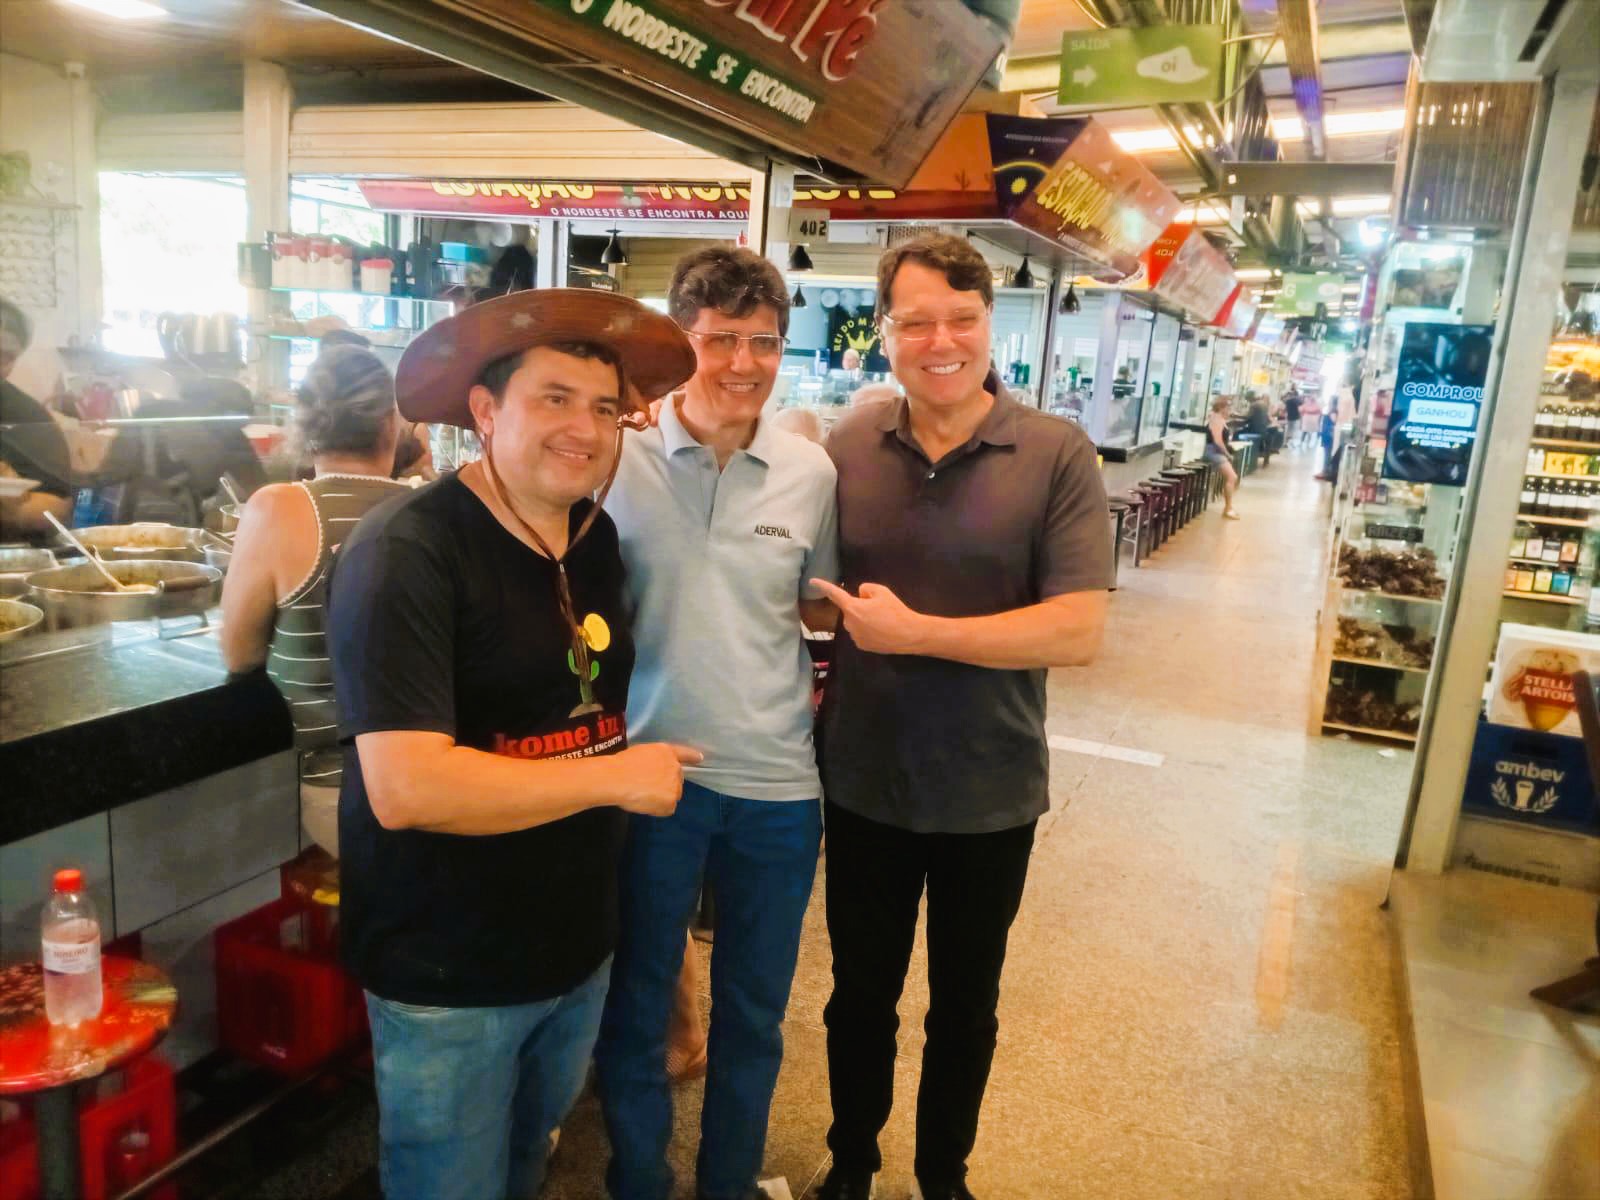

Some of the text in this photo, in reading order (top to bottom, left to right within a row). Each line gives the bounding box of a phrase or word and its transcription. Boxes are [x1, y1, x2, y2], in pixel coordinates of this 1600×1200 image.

[603, 0, 708, 69] NORDESTE
[710, 53, 738, 84] SE
[551, 208, 749, 219] O NORDESTE SE ENCONTRA AQUI
[800, 221, 827, 236] 402
[841, 320, 855, 333] DO
[1416, 406, 1466, 419] GANHOU
[754, 524, 793, 539] ADERVAL
[1520, 686, 1576, 703] ARTOIS
[583, 746, 594, 756] SE
[1495, 760, 1565, 783] ambev
